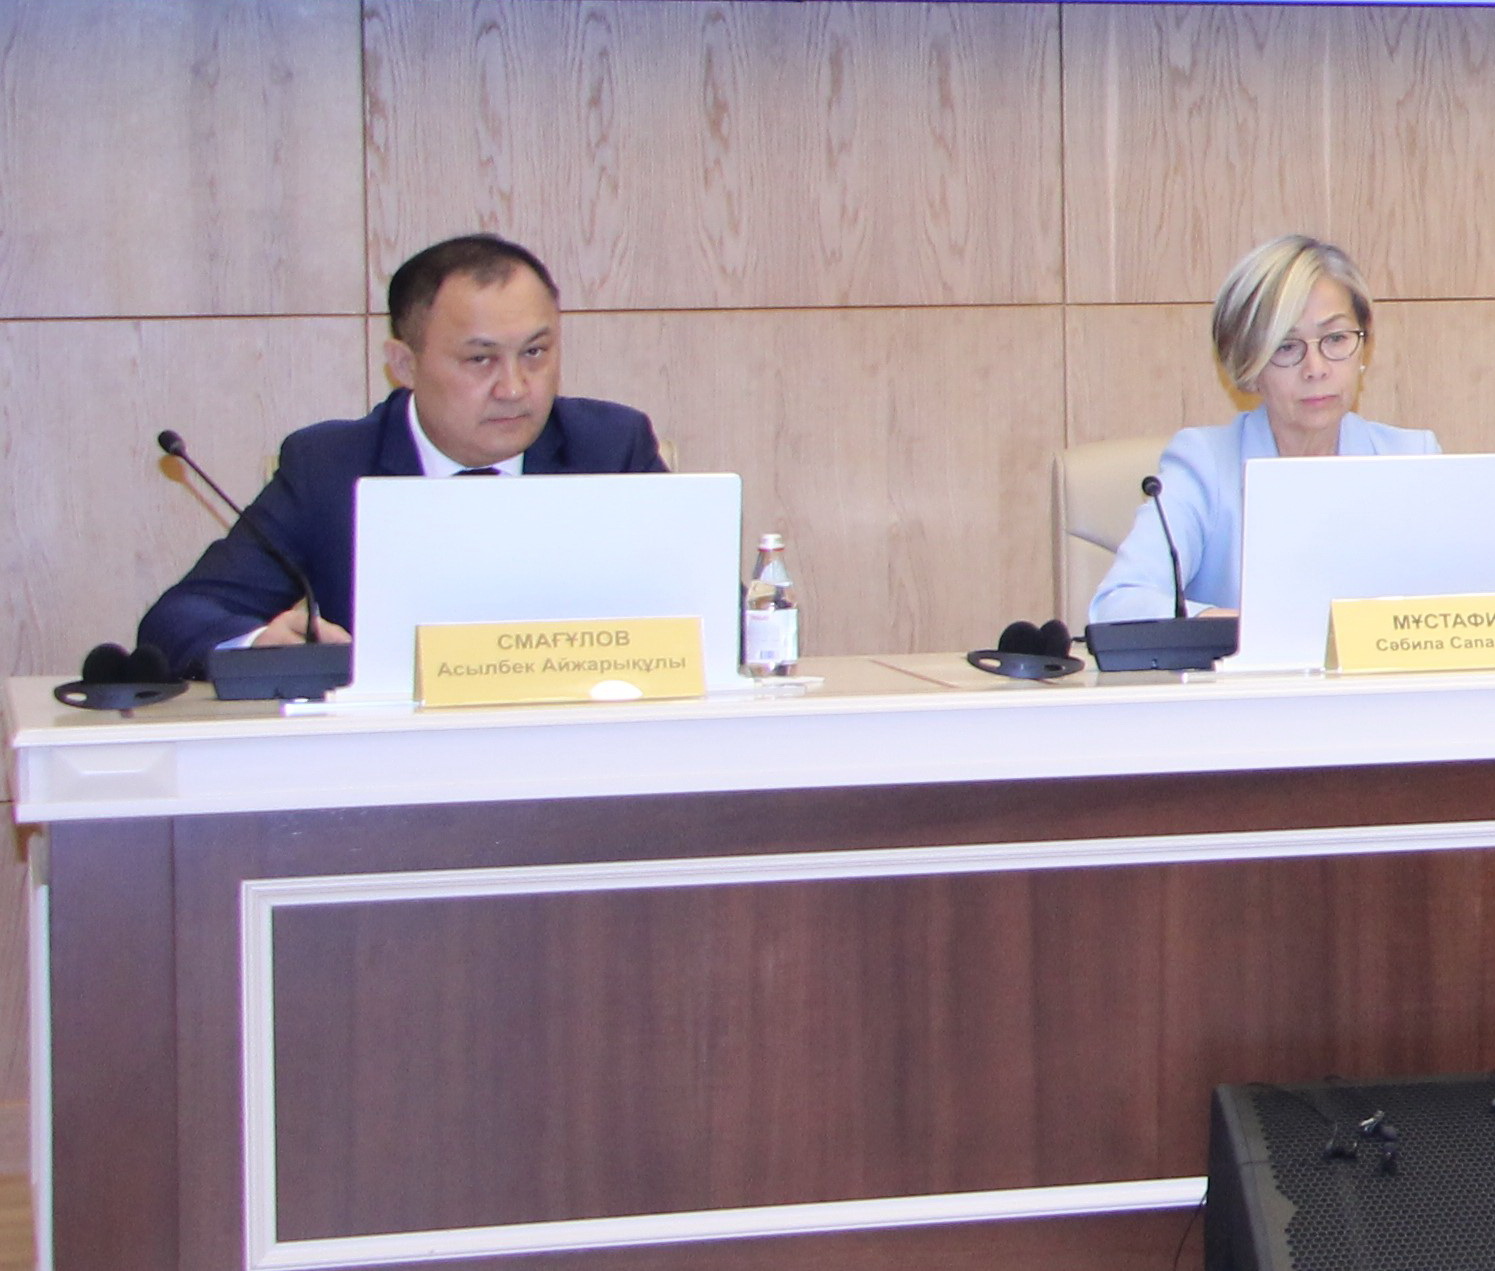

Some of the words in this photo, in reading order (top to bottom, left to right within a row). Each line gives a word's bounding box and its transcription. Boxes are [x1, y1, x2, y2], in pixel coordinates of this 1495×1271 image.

[498, 630, 630, 650] СМАҒҰЛОВ
[1376, 638, 1444, 652] Сәбила
[437, 660, 536, 678] Асылбек
[542, 656, 686, 674] Айжарықұлы
